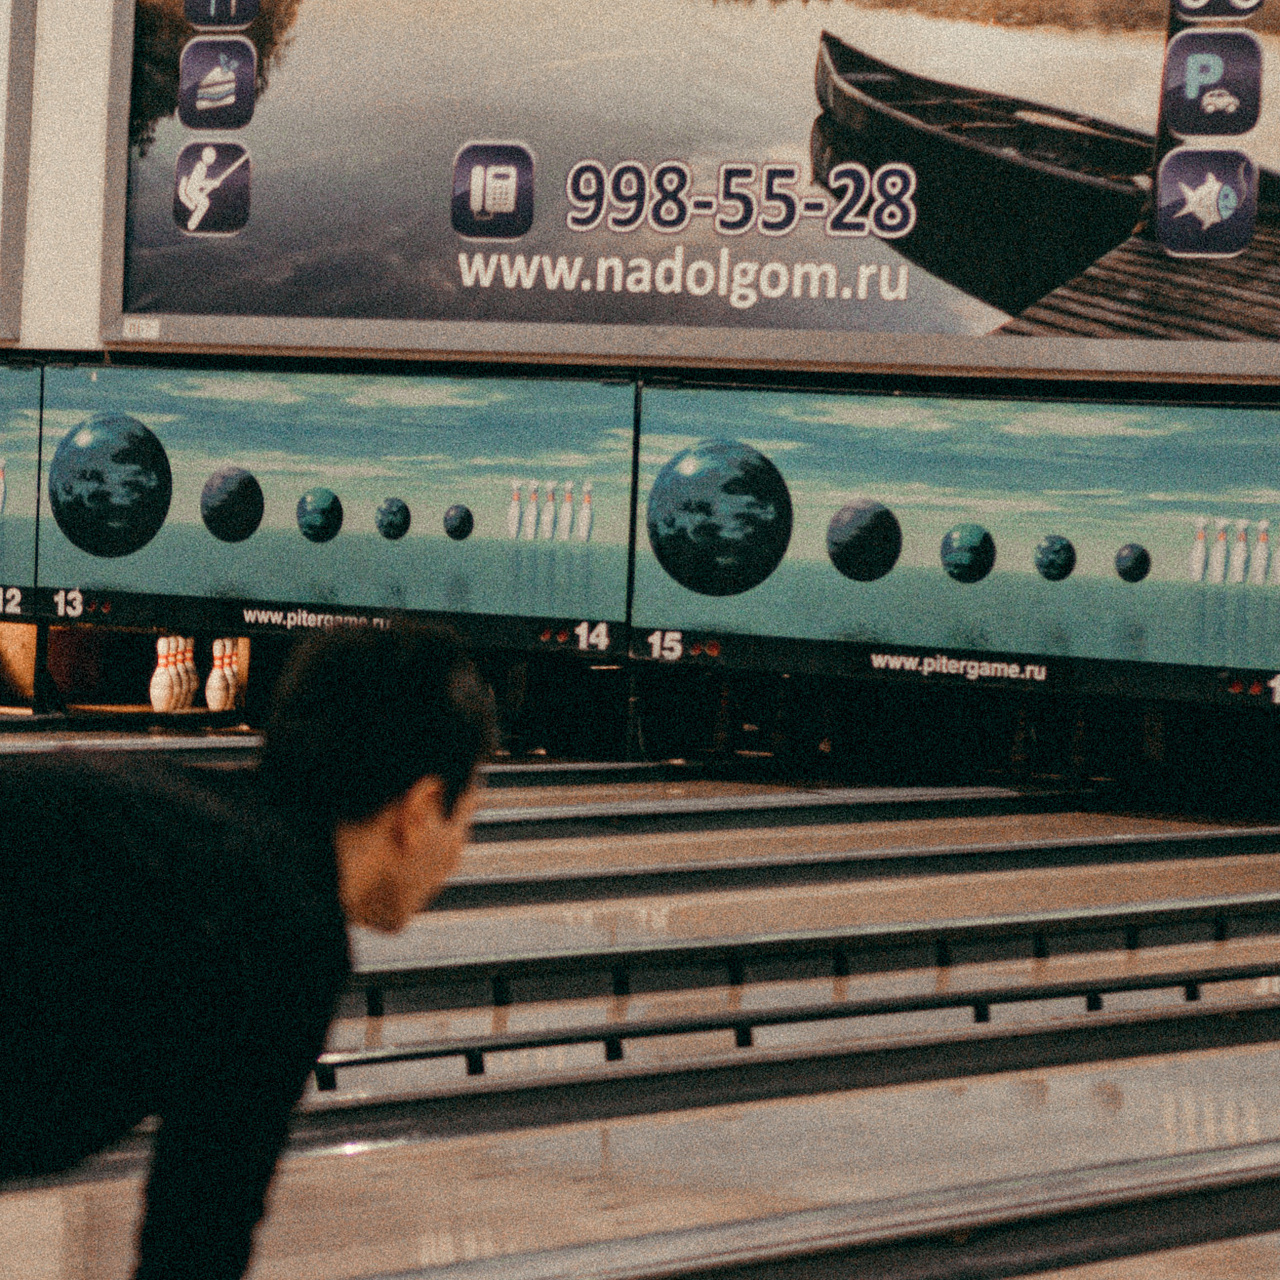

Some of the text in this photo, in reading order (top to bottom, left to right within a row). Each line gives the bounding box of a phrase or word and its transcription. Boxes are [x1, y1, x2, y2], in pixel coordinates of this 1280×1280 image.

[566, 158, 919, 239] 998-55-28
[456, 244, 910, 310] www.nadolgom.ru
[52, 589, 84, 618] 13
[573, 621, 610, 651] 14
[646, 631, 683, 662] 15
[870, 651, 1047, 684] www.pitergame.ru
